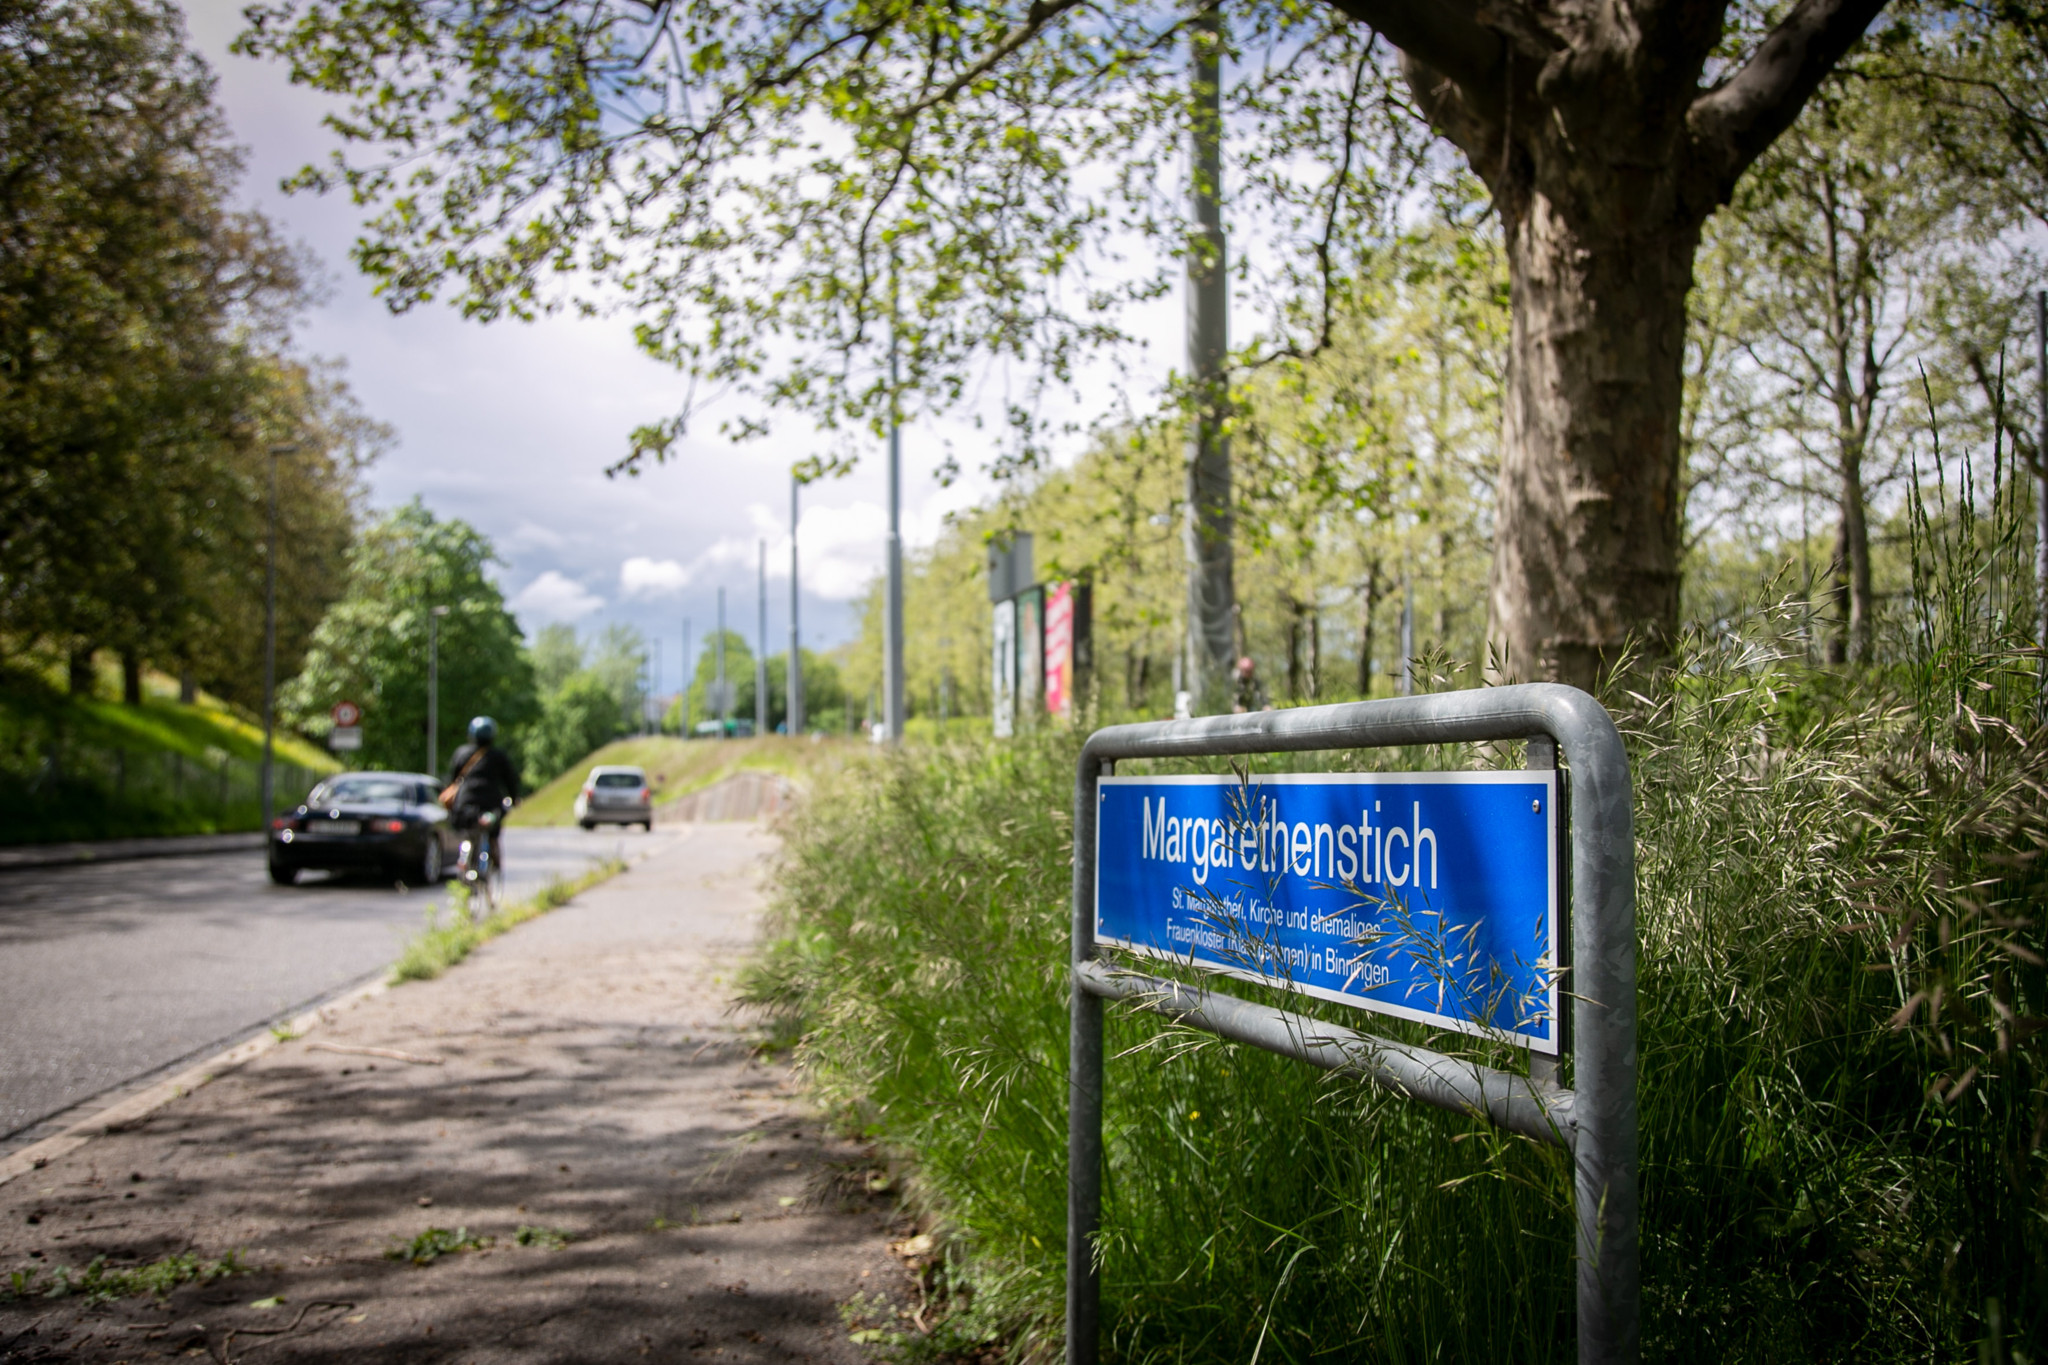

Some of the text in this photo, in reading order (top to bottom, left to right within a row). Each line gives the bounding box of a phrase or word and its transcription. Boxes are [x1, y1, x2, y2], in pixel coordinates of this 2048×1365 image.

[1142, 796, 1437, 889] Margarethenstich
[1166, 917, 1225, 949] Frauenkloster
[1311, 945, 1322, 970] in
[1325, 947, 1389, 987] Binningen
[1172, 887, 1184, 909] St.
[1250, 898, 1283, 926] Kirche
[1286, 906, 1308, 930] und
[1310, 908, 1381, 947] ehemaliges
